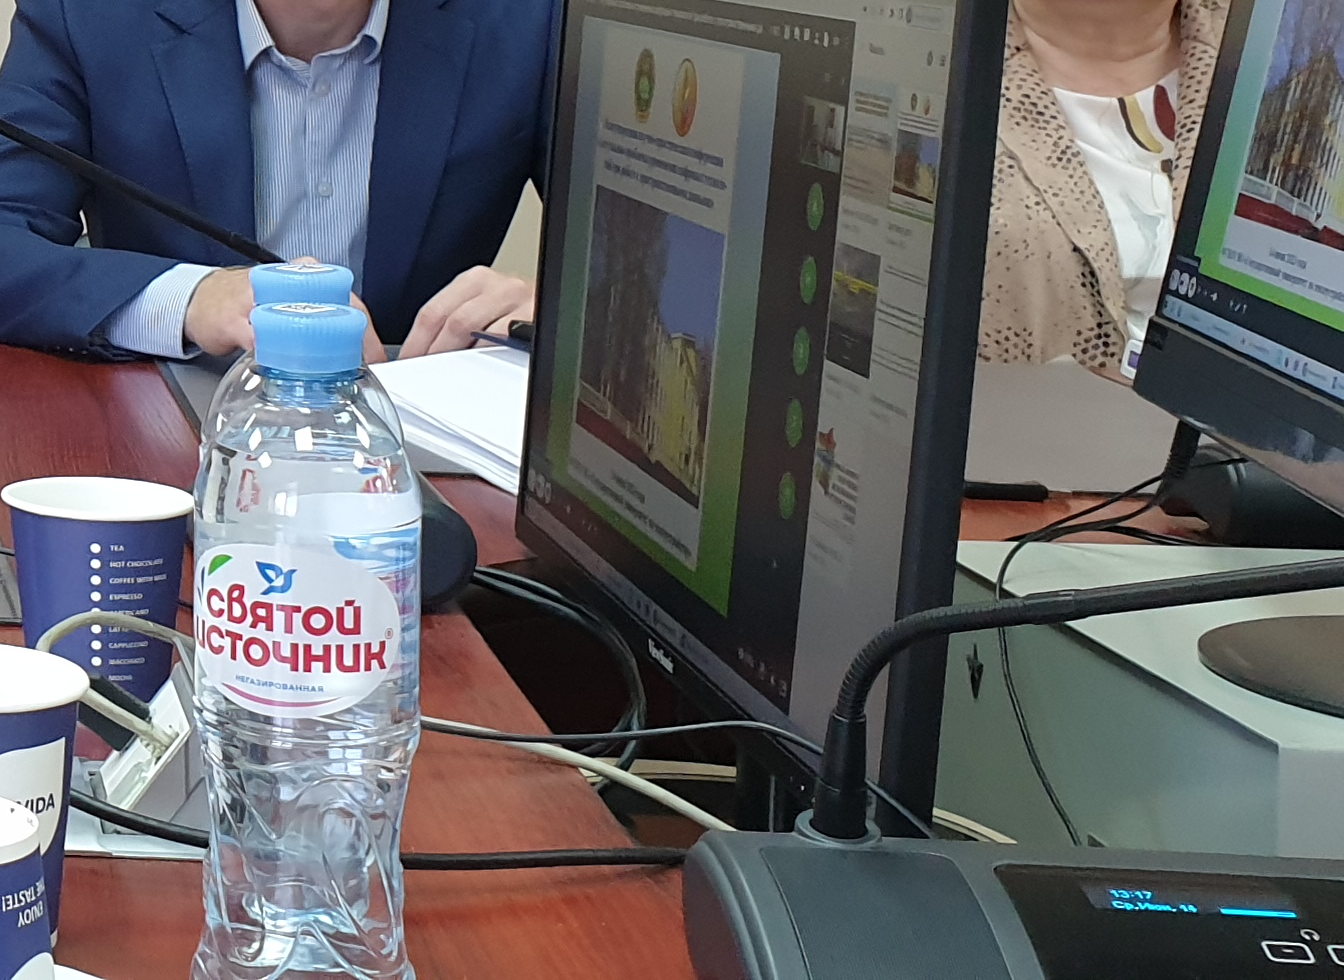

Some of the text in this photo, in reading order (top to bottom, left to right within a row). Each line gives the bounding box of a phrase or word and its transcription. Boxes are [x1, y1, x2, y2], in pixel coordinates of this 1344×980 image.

[109, 544, 125, 552] TEA
[109, 560, 125, 568] HOT
[109, 576, 135, 584] COFFEE
[206, 583, 361, 636] СВЯТОЙ
[235, 674, 324, 693] НЕГАЗИРОВАННАЯ
[1, 886, 37, 912] TASTE!
[1109, 889, 1153, 899] 13:17
[17, 900, 44, 928] ENJOY
